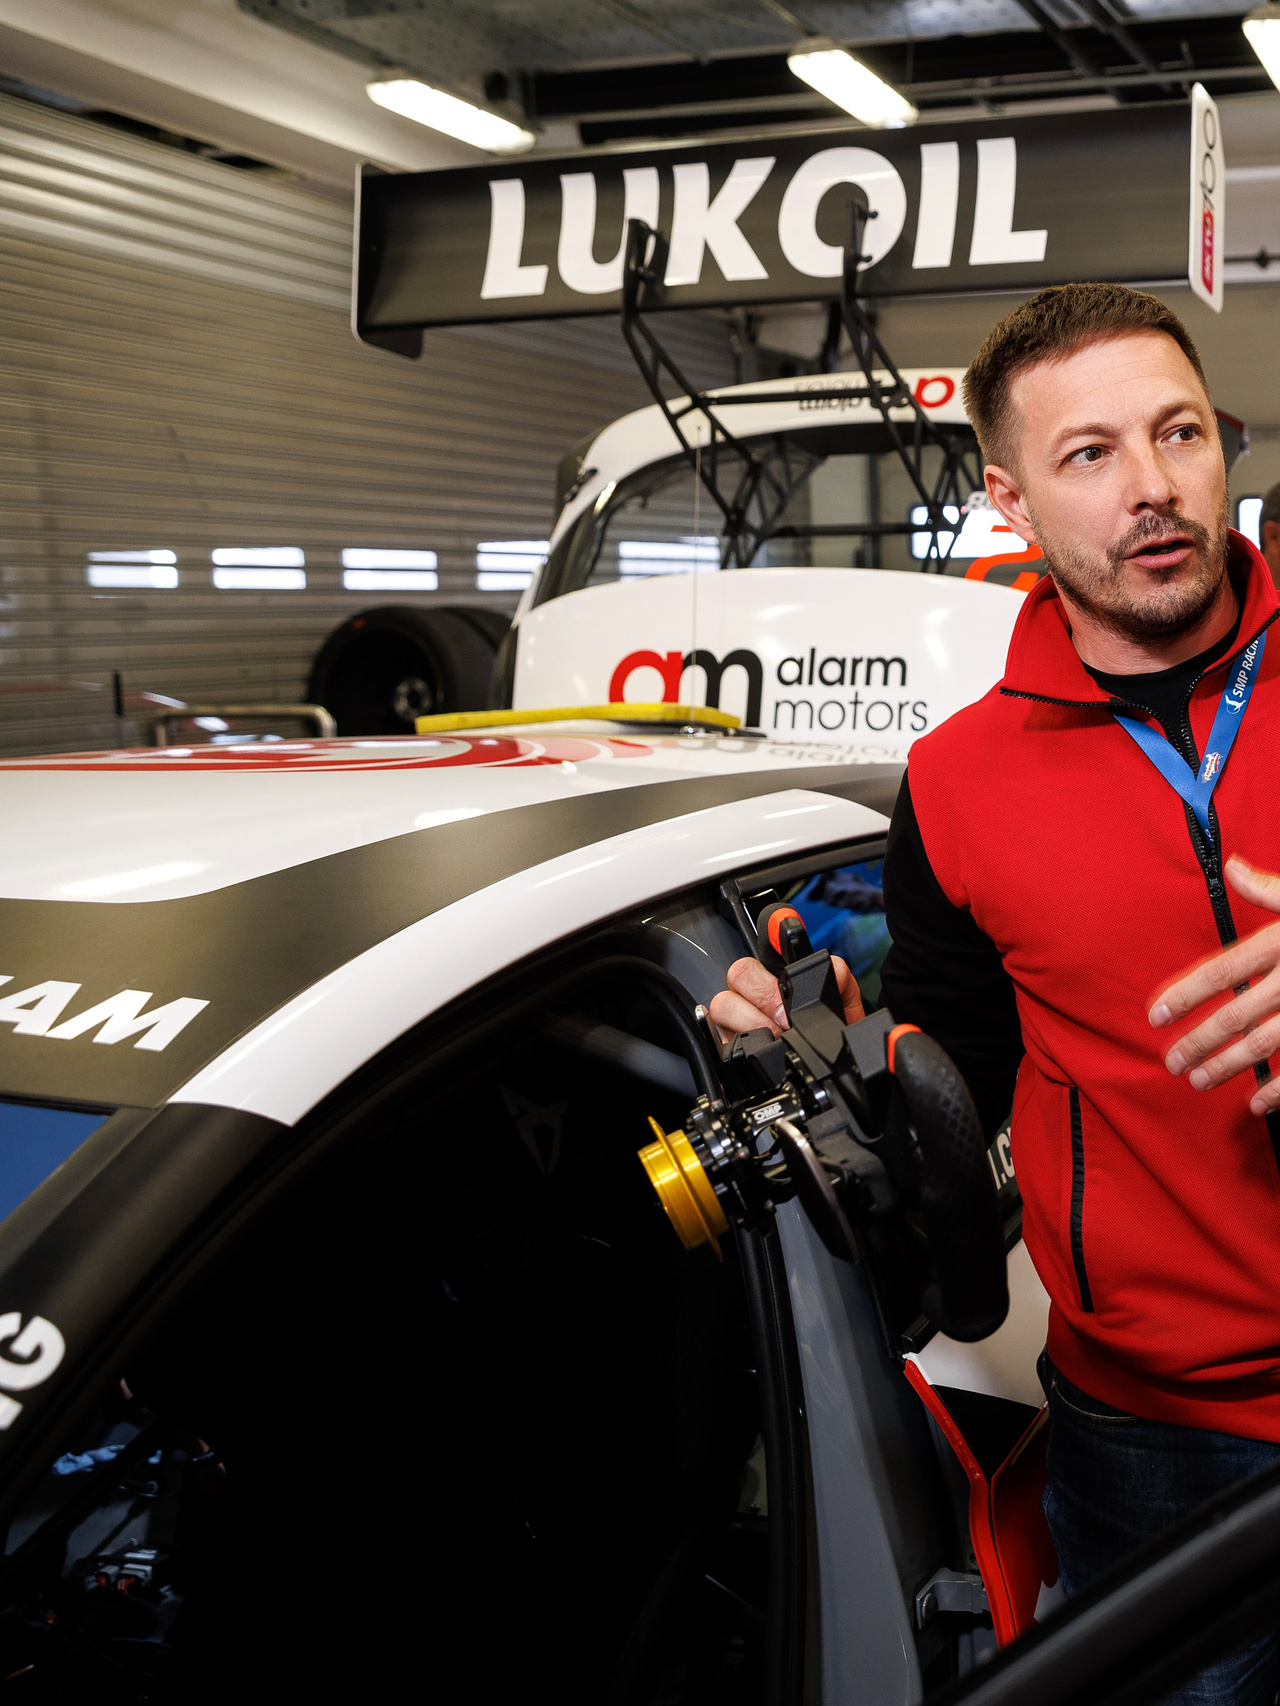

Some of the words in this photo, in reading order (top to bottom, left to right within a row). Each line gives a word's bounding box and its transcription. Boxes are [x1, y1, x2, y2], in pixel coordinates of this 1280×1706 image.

[481, 137, 1047, 299] LUKOIL
[609, 649, 763, 727] am
[777, 647, 906, 688] alarm
[1232, 669, 1248, 698] SMP
[774, 692, 928, 733] motors
[0, 975, 211, 1052] AM
[754, 1104, 782, 1121] OMP
